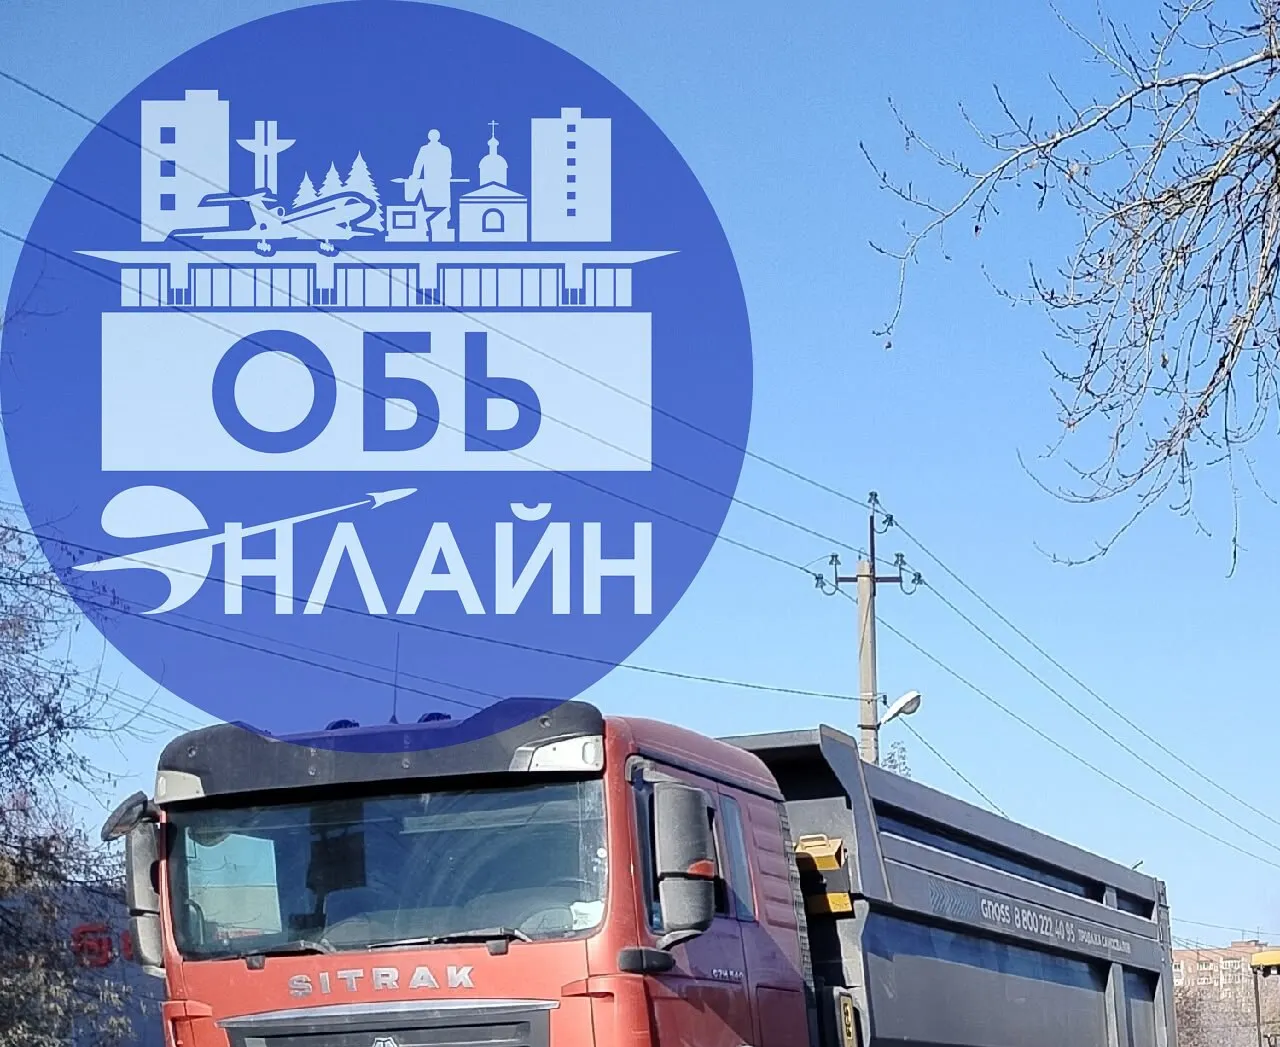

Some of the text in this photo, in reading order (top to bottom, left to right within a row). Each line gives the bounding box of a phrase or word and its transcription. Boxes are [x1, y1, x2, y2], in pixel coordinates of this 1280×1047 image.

[1014, 906, 1021, 929] 8
[1021, 909, 1039, 933] 800
[1039, 914, 1053, 937] 222
[288, 965, 475, 997] SITRAK
